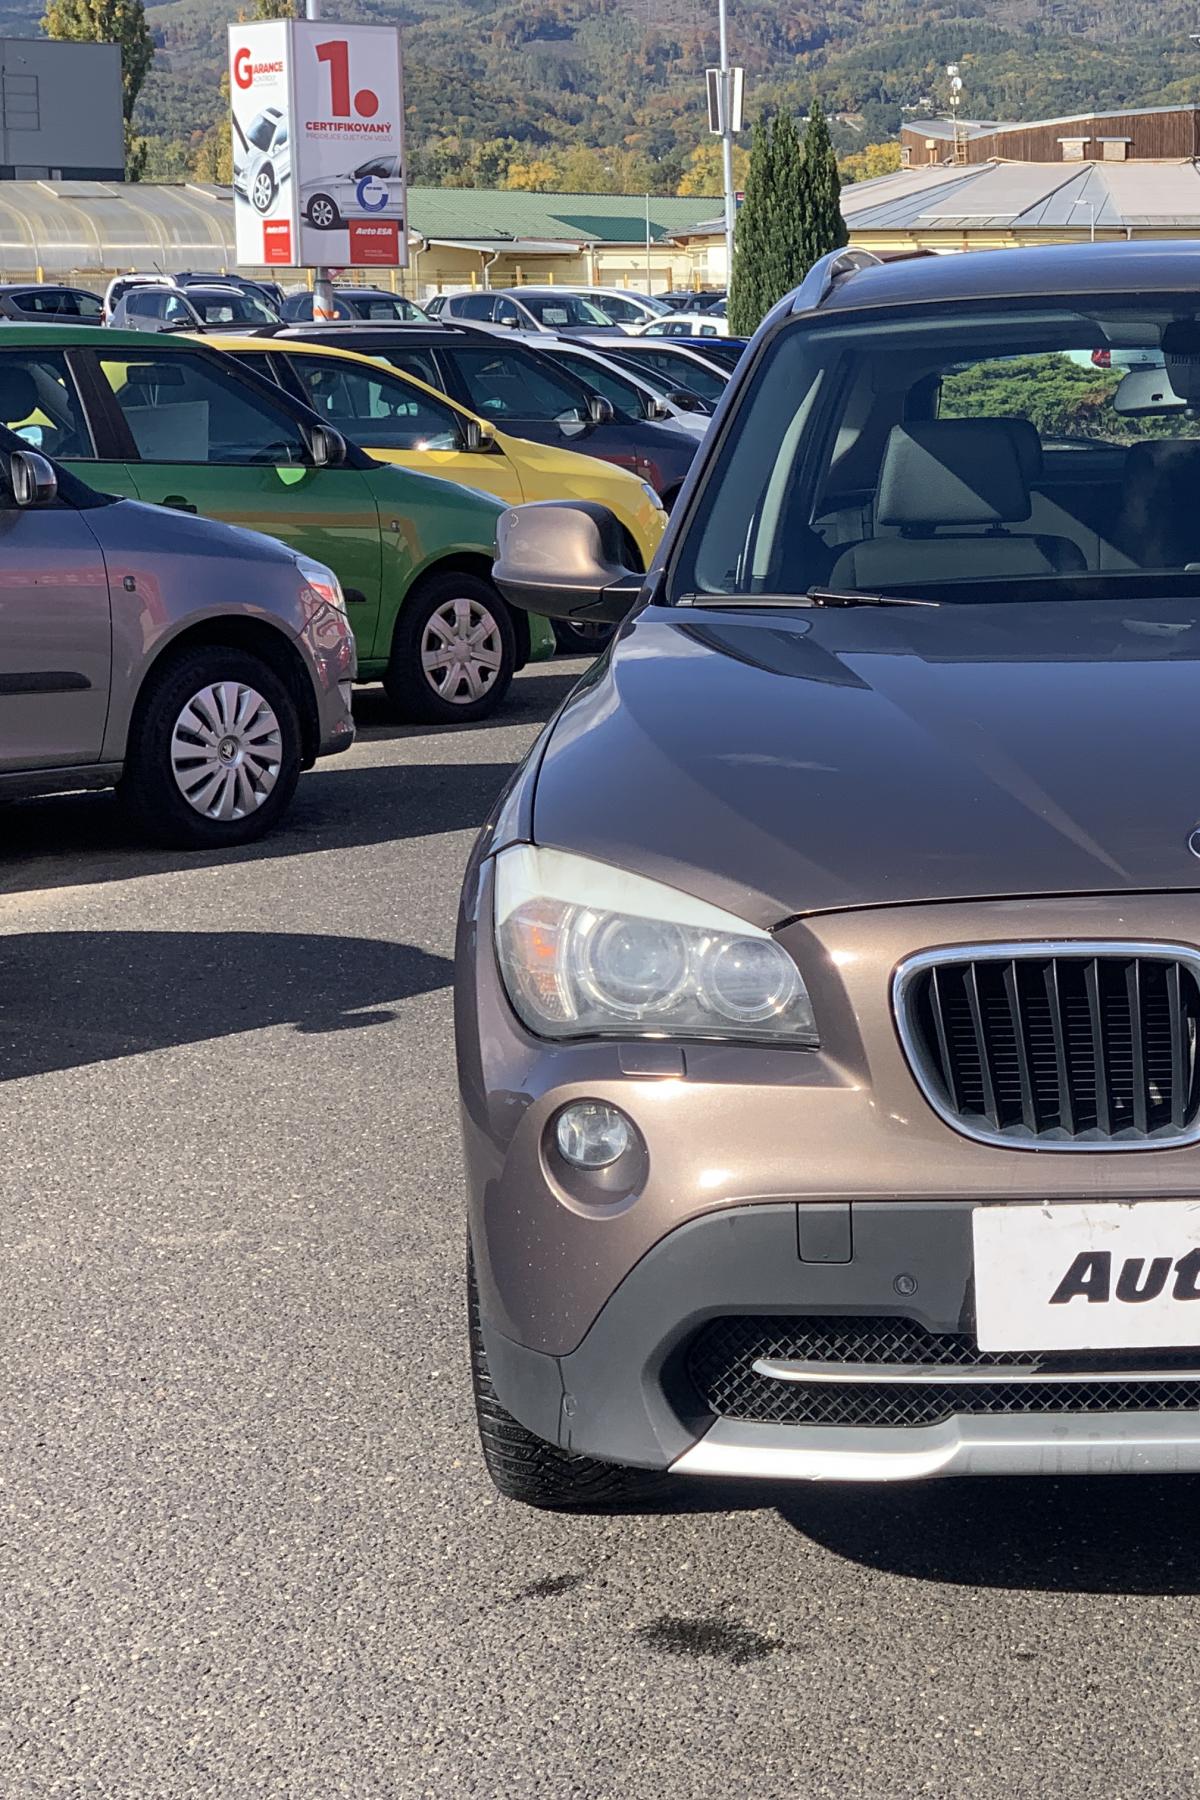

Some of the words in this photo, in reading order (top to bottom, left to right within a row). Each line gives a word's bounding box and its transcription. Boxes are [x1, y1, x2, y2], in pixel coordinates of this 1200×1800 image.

[234, 47, 284, 89] GARANCE
[315, 40, 379, 117] 1.
[305, 121, 392, 133] CERTIFIKOVANÝ
[356, 227, 376, 235] Auto
[376, 227, 393, 235] ESA
